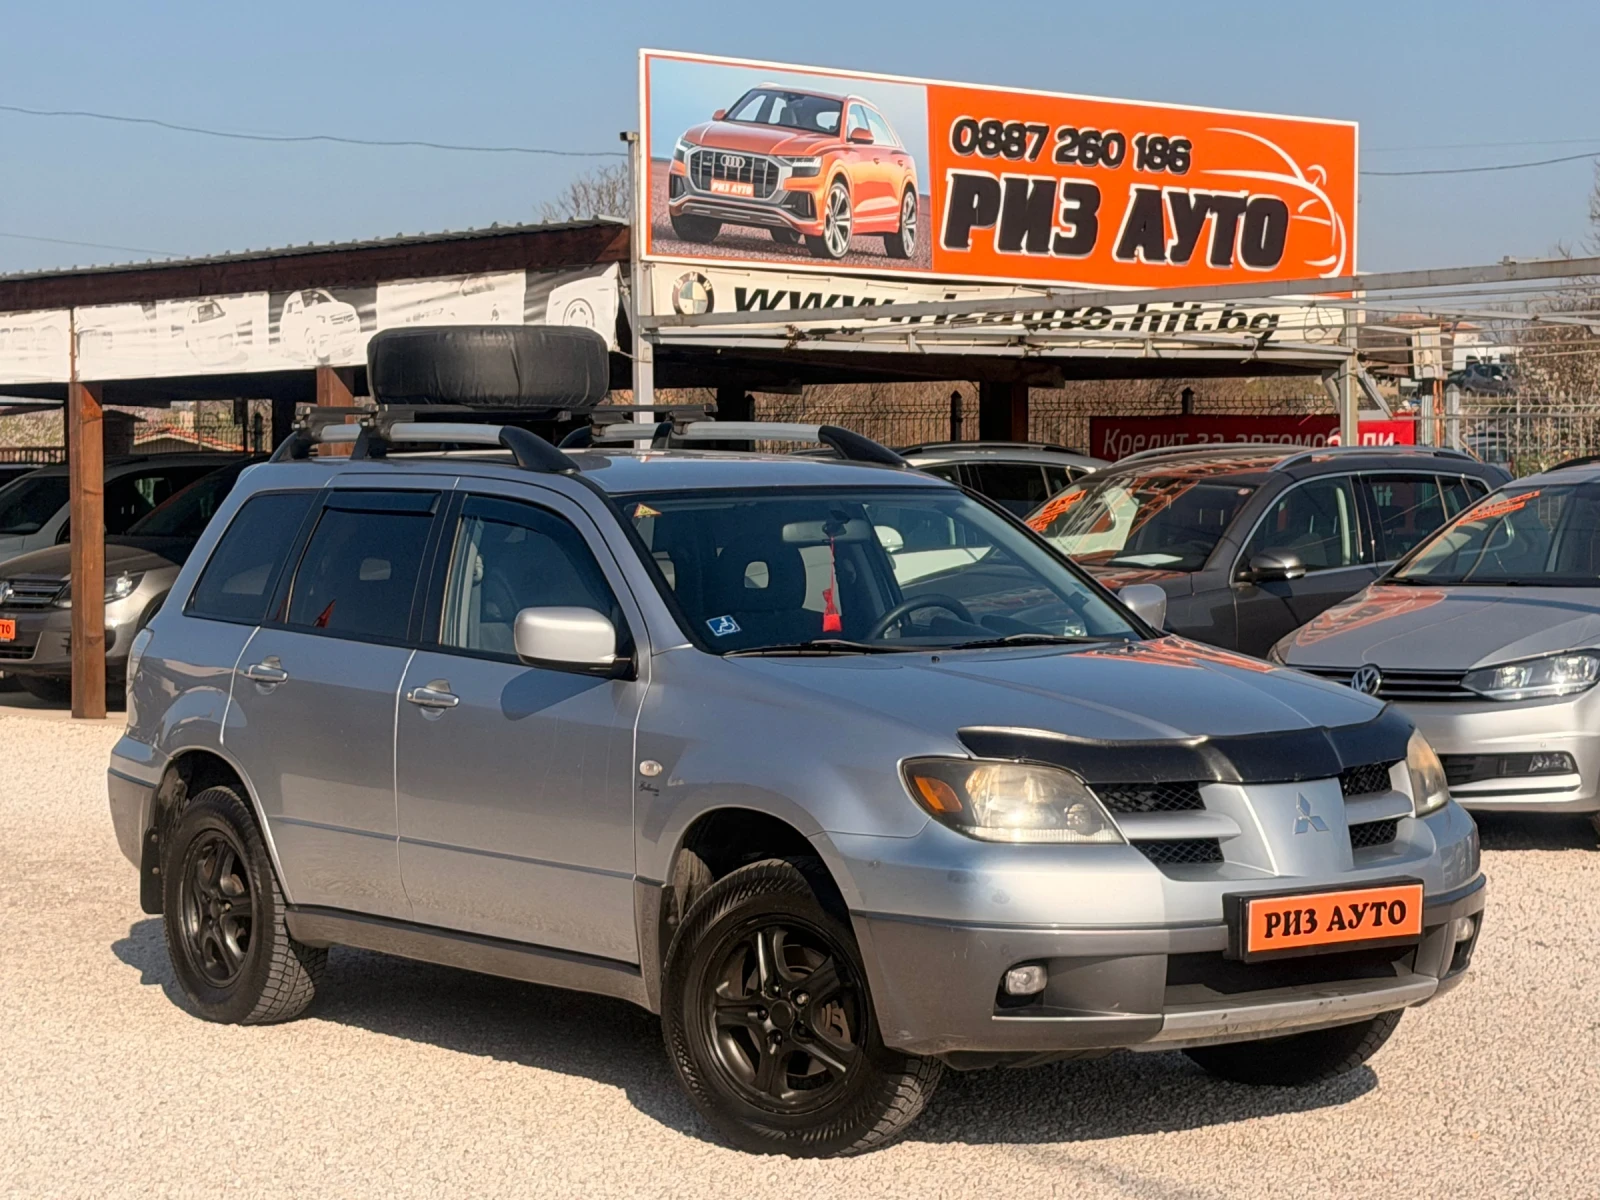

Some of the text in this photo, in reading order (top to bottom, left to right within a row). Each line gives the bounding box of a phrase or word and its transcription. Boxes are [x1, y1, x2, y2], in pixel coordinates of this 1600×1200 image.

[951, 116, 1192, 175] 0887 260 186
[941, 169, 1289, 271] РИЗ АУТО
[1264, 899, 1406, 938] РИЗ АУТО
